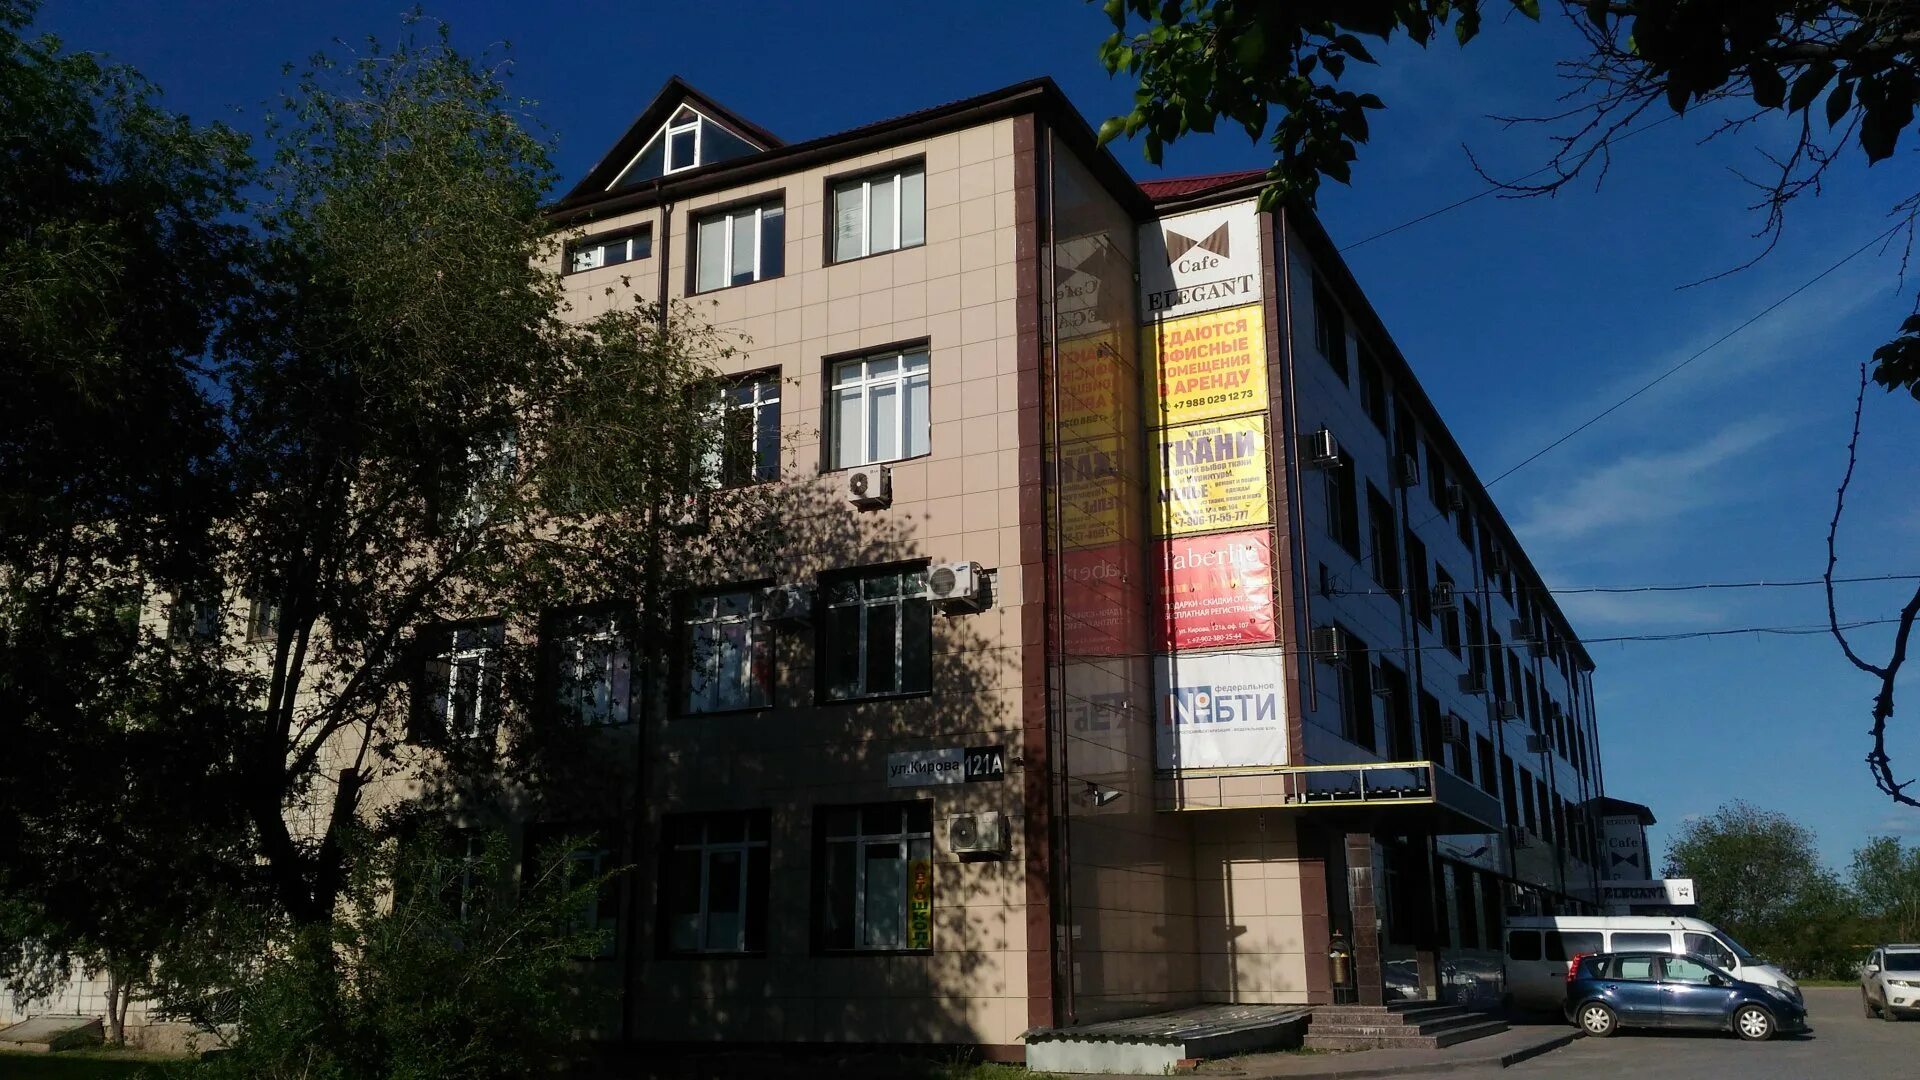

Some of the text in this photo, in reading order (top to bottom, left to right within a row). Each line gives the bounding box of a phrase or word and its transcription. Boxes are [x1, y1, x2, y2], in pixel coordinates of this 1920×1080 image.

[1178, 256, 1219, 274] Cafe
[1148, 274, 1254, 311] ELEGANT
[1158, 319, 1247, 347] СДАЮТСЯ
[1159, 337, 1248, 364] ОФИСНЫЕ
[1158, 354, 1250, 382] ПОМЕЩЕНИЯ
[1158, 369, 1250, 397] В АРЕНДУ
[1174, 389, 1253, 409] +7 988 029 12 73
[1157, 430, 1255, 467] ТКАНИ
[1214, 683, 1275, 692] федеральное
[965, 753, 1004, 776] 121А
[1608, 837, 1638, 848] Cafe
[1603, 886, 1667, 899] ELEGANT
